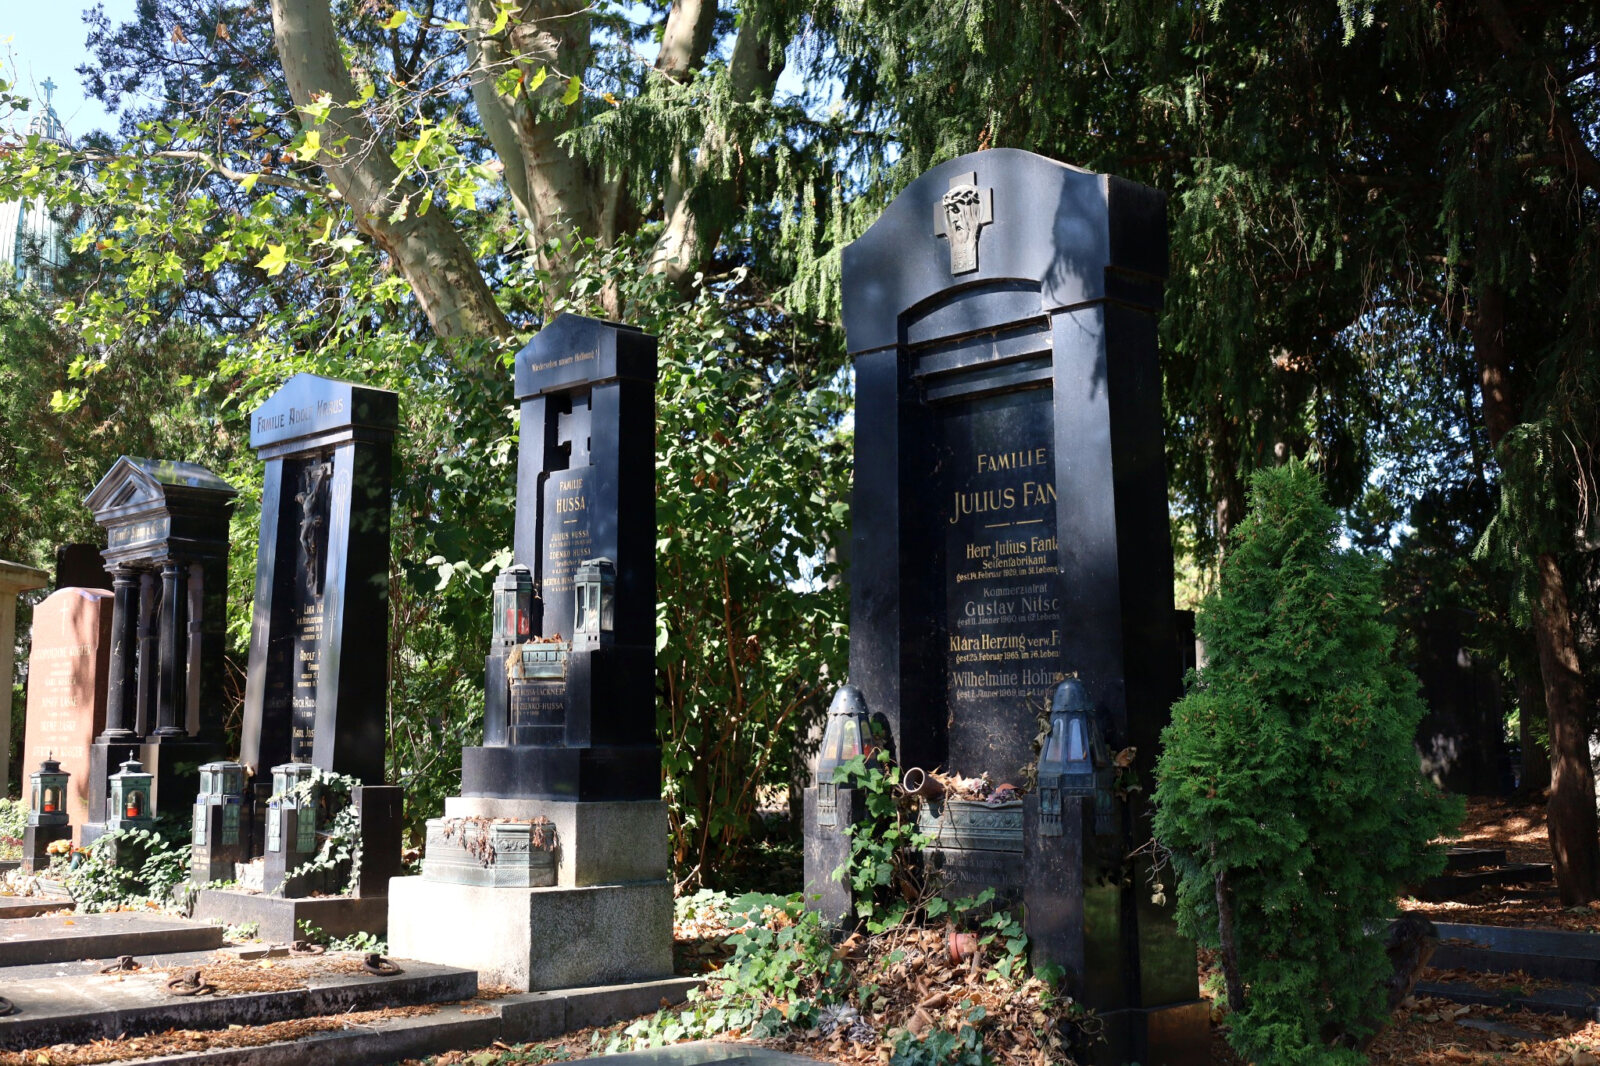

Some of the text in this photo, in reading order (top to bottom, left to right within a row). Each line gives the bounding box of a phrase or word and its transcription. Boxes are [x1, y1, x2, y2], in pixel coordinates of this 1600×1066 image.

[257, 414, 285, 433] FAMILIE
[288, 407, 313, 425] ADOLF
[977, 448, 1047, 473] FAMILIE
[559, 478, 583, 491] FAMILIE
[556, 496, 585, 513] HUSSA
[949, 487, 1016, 524] JULIUS
[966, 543, 991, 559] Herr
[992, 540, 1027, 558] Julius
[982, 555, 1047, 570] Seifenfabrikant
[983, 583, 1047, 598] Kommerzialrat
[965, 600, 1015, 617] Gustav
[949, 635, 980, 652] Klara
[982, 633, 1026, 652] Herzing
[1051, 629, 1061, 646] F
[952, 669, 1018, 687] Wilhelmine
